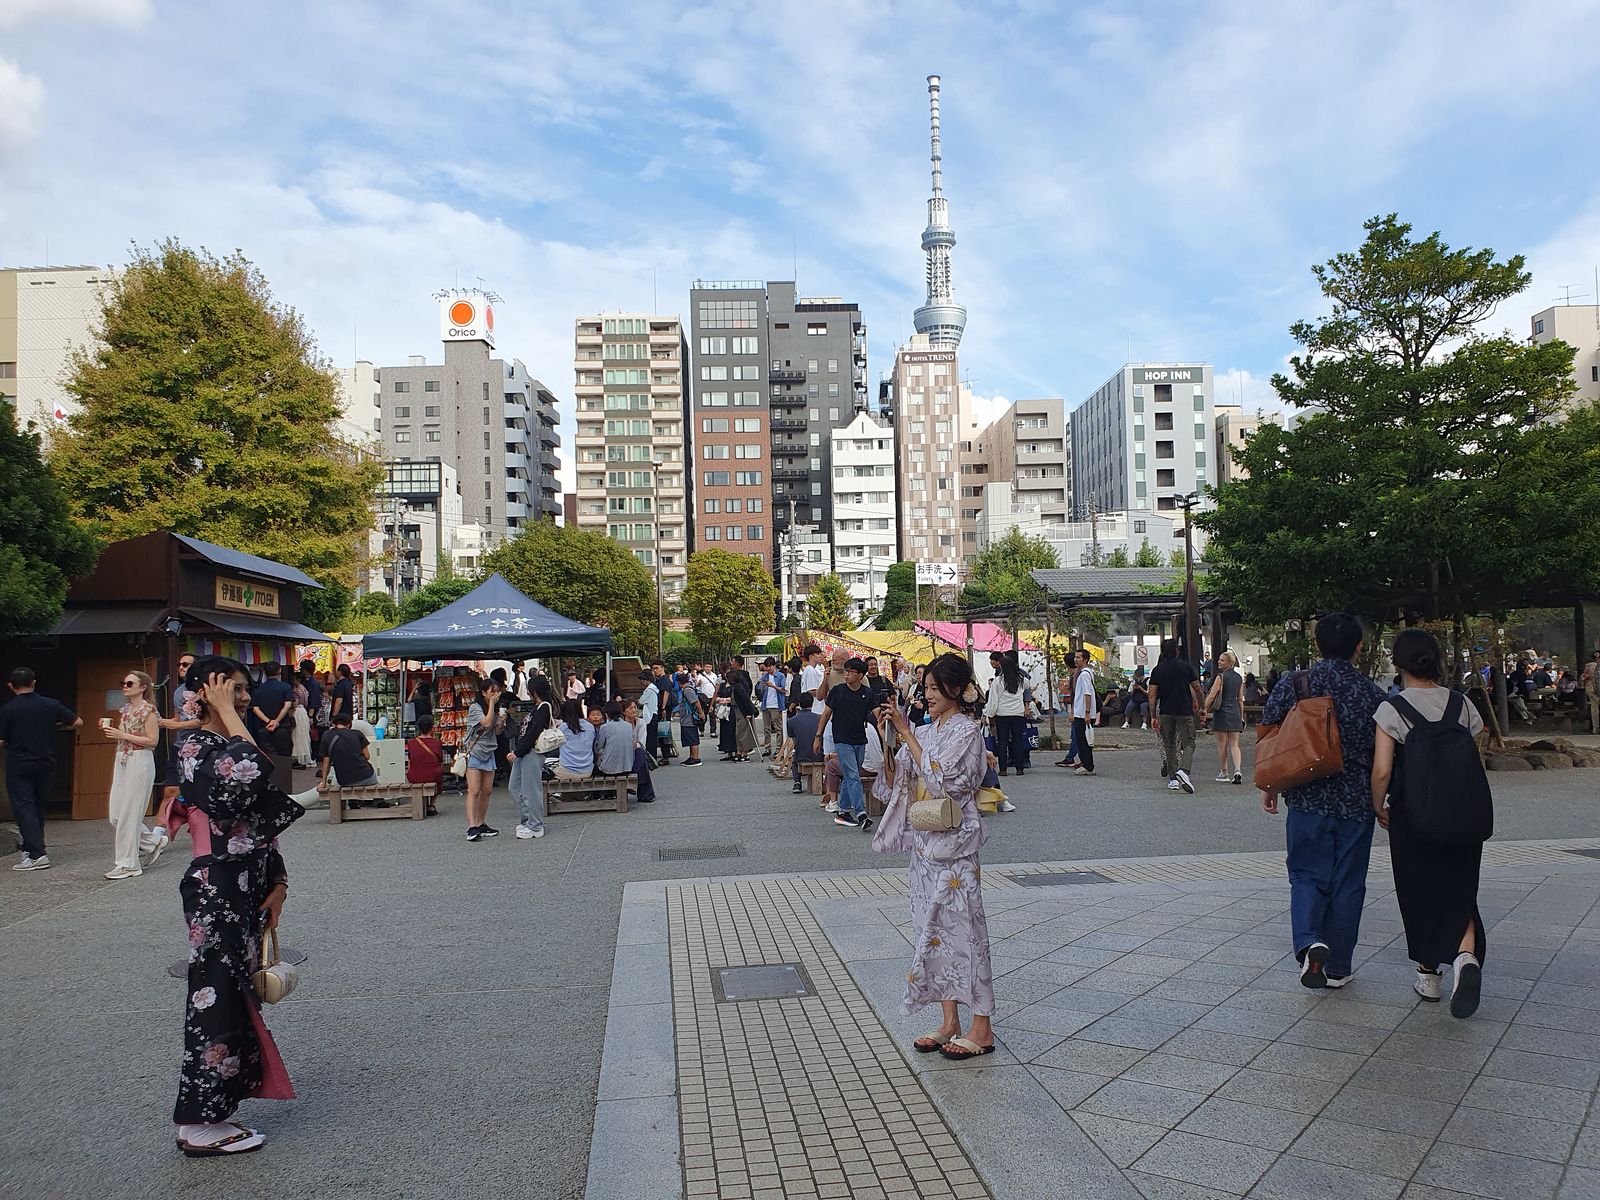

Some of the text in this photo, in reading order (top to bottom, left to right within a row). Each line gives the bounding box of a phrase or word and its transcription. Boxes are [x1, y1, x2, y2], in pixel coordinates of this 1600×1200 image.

[449, 328, 476, 337] Orico
[1144, 370, 1191, 381] HOP INN
[917, 564, 942, 574] お手洗
